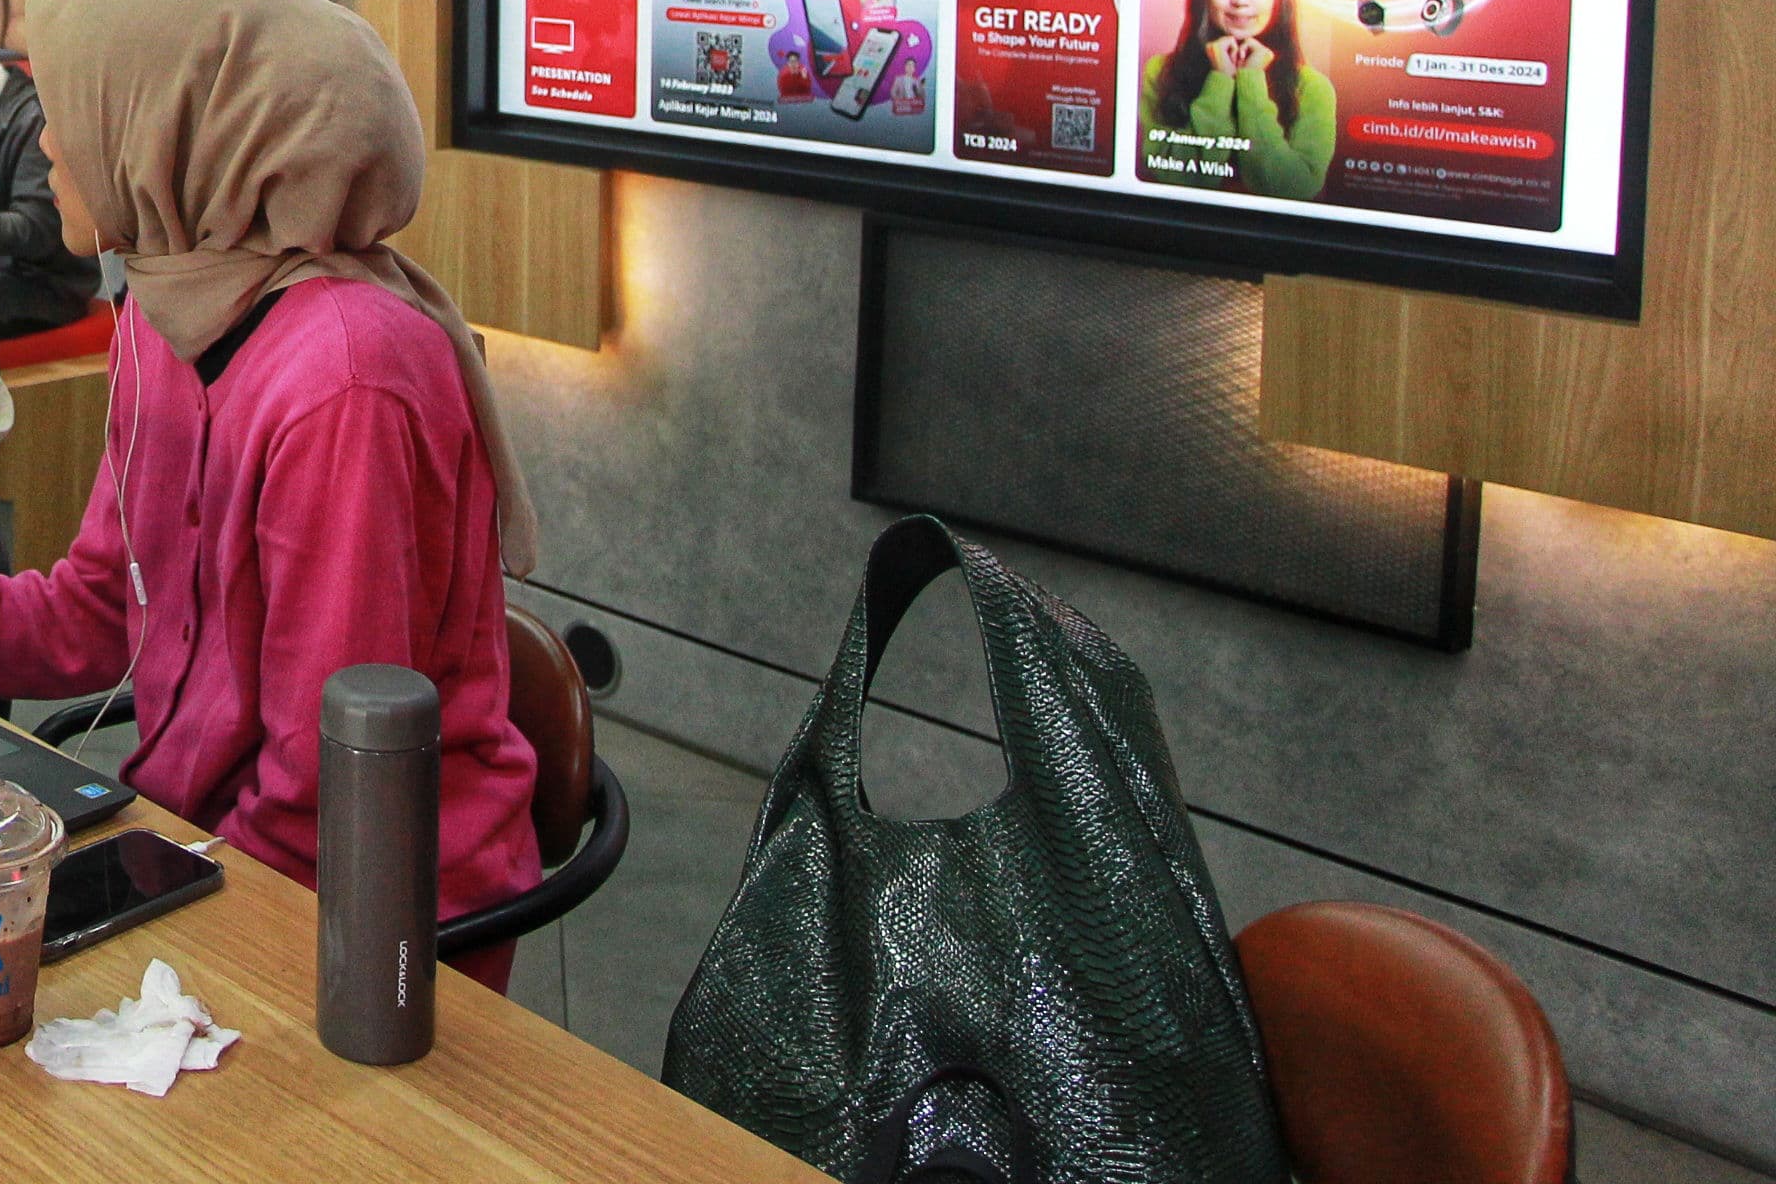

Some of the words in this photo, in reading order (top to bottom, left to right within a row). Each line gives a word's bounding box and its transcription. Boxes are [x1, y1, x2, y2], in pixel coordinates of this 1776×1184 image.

[975, 7, 1018, 29] GET
[1023, 9, 1101, 35] READY
[972, 31, 984, 43] to
[987, 31, 1026, 47] Shape
[1029, 34, 1056, 48] Your
[1059, 38, 1099, 52] Future
[531, 66, 611, 86] PRESENTATION
[1355, 53, 1404, 69] Periode
[1416, 59, 1421, 69] 1
[1424, 59, 1448, 72] Jan
[1460, 61, 1474, 72] 31
[1479, 64, 1504, 75] Des
[1508, 65, 1541, 78] 2024
[531, 84, 549, 98] See
[551, 86, 593, 102] Schedule
[671, 78, 710, 95] February
[658, 99, 693, 113] Aplikasi
[695, 103, 719, 118] Kejar
[720, 105, 752, 121] Mimpi
[752, 109, 778, 123] 2024
[1388, 97, 1410, 110] Info
[1412, 100, 1439, 112] lebih
[1441, 102, 1476, 117] lanjut,
[1478, 105, 1504, 118] S&K:
[964, 132, 985, 149] TCB
[987, 135, 1017, 152] 2024
[1149, 129, 1166, 143] 09
[1167, 131, 1217, 150] January
[1217, 135, 1250, 152] 2024
[1362, 121, 1537, 150] cimb.id/dl/makeawish
[1148, 154, 1184, 173] Make
[1185, 158, 1198, 174] A
[1199, 159, 1234, 178] Wish
[397, 940, 408, 1008] LOCK&LOCK
